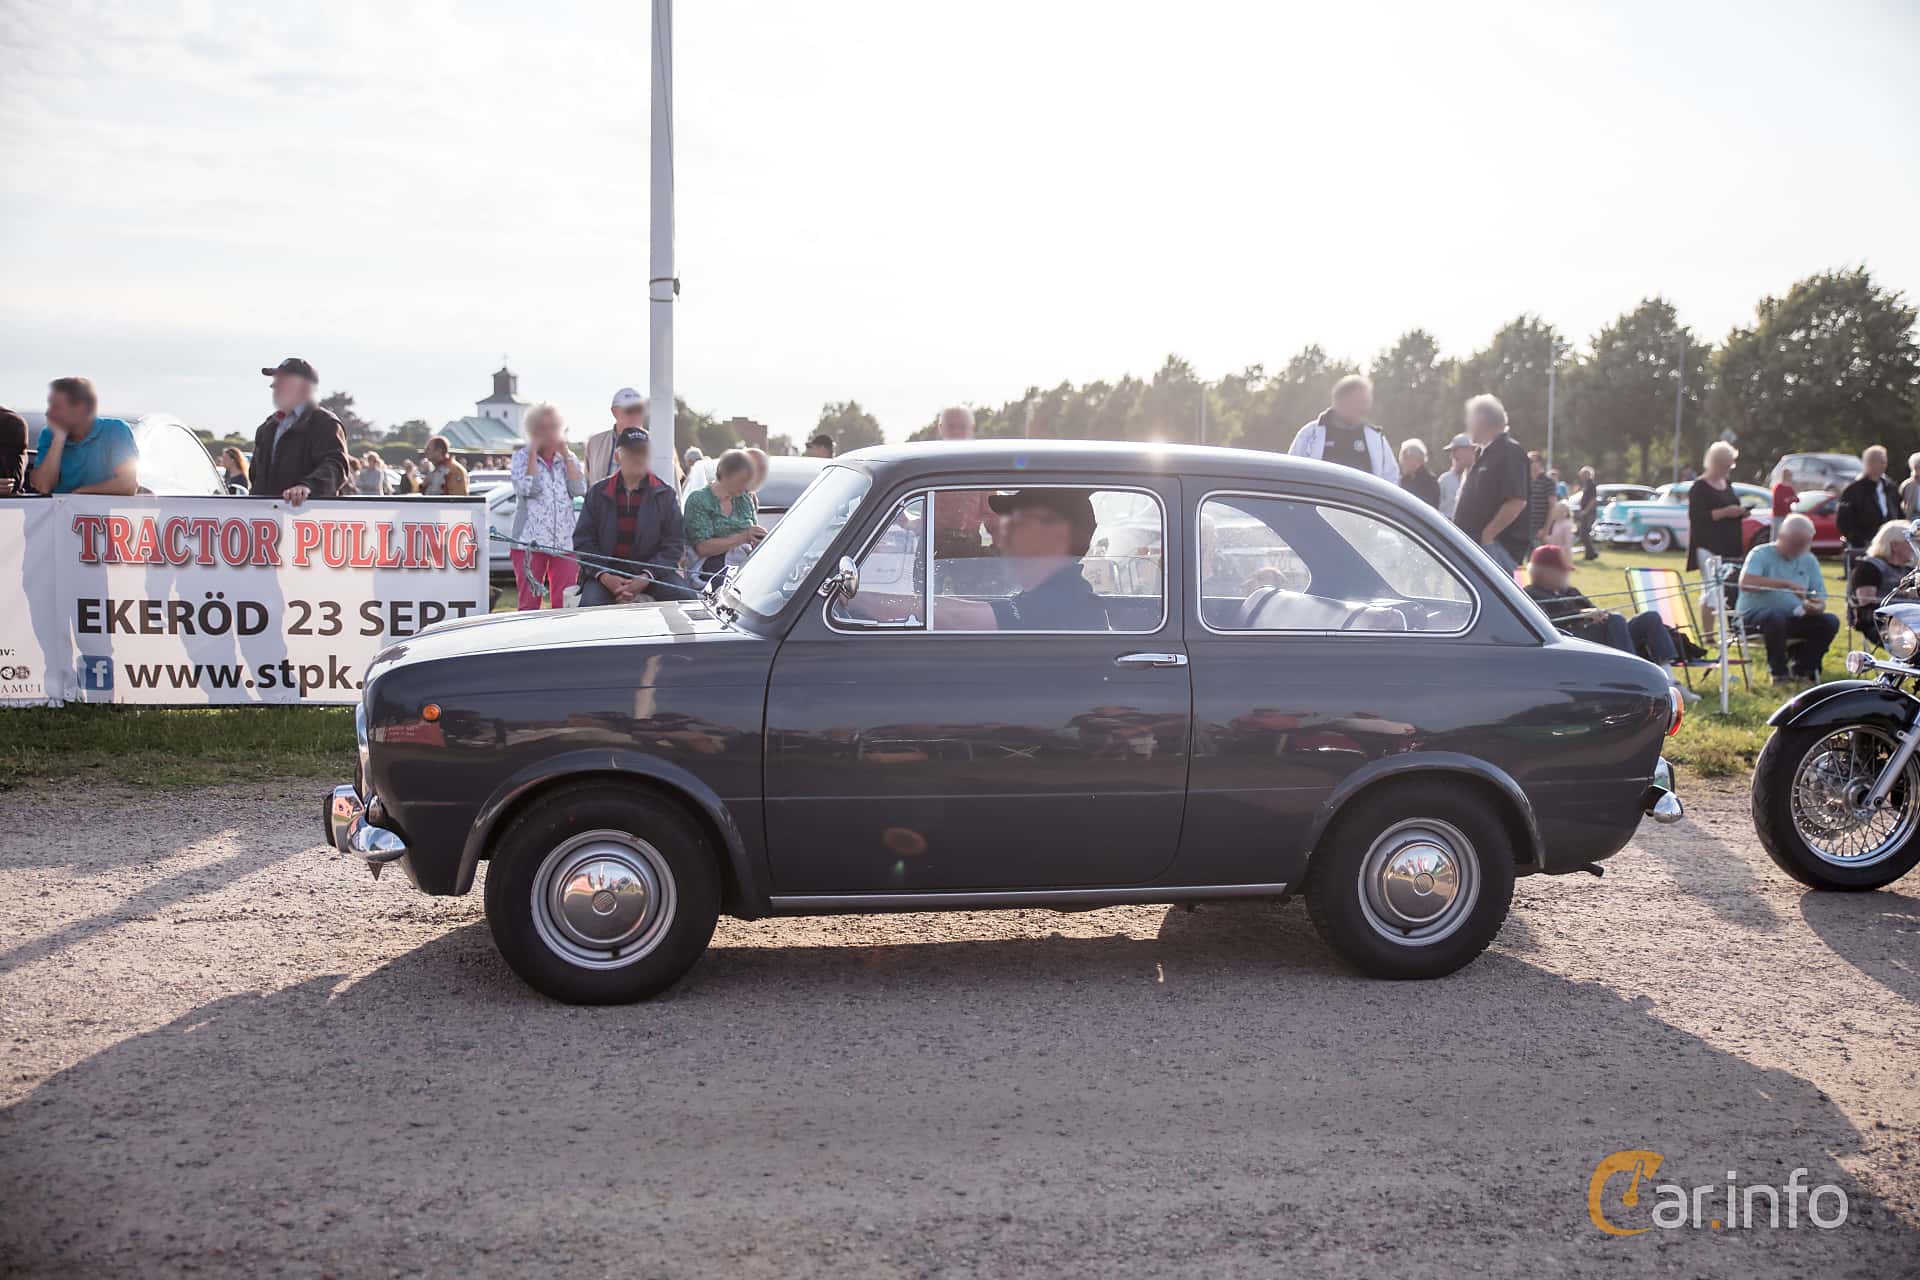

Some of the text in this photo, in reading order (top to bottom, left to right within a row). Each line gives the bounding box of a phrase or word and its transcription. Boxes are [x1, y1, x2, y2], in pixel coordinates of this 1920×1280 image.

[72, 514, 478, 569] TRACTOR PULLING
[77, 591, 269, 635] EKERÖD
[287, 600, 343, 635] 23
